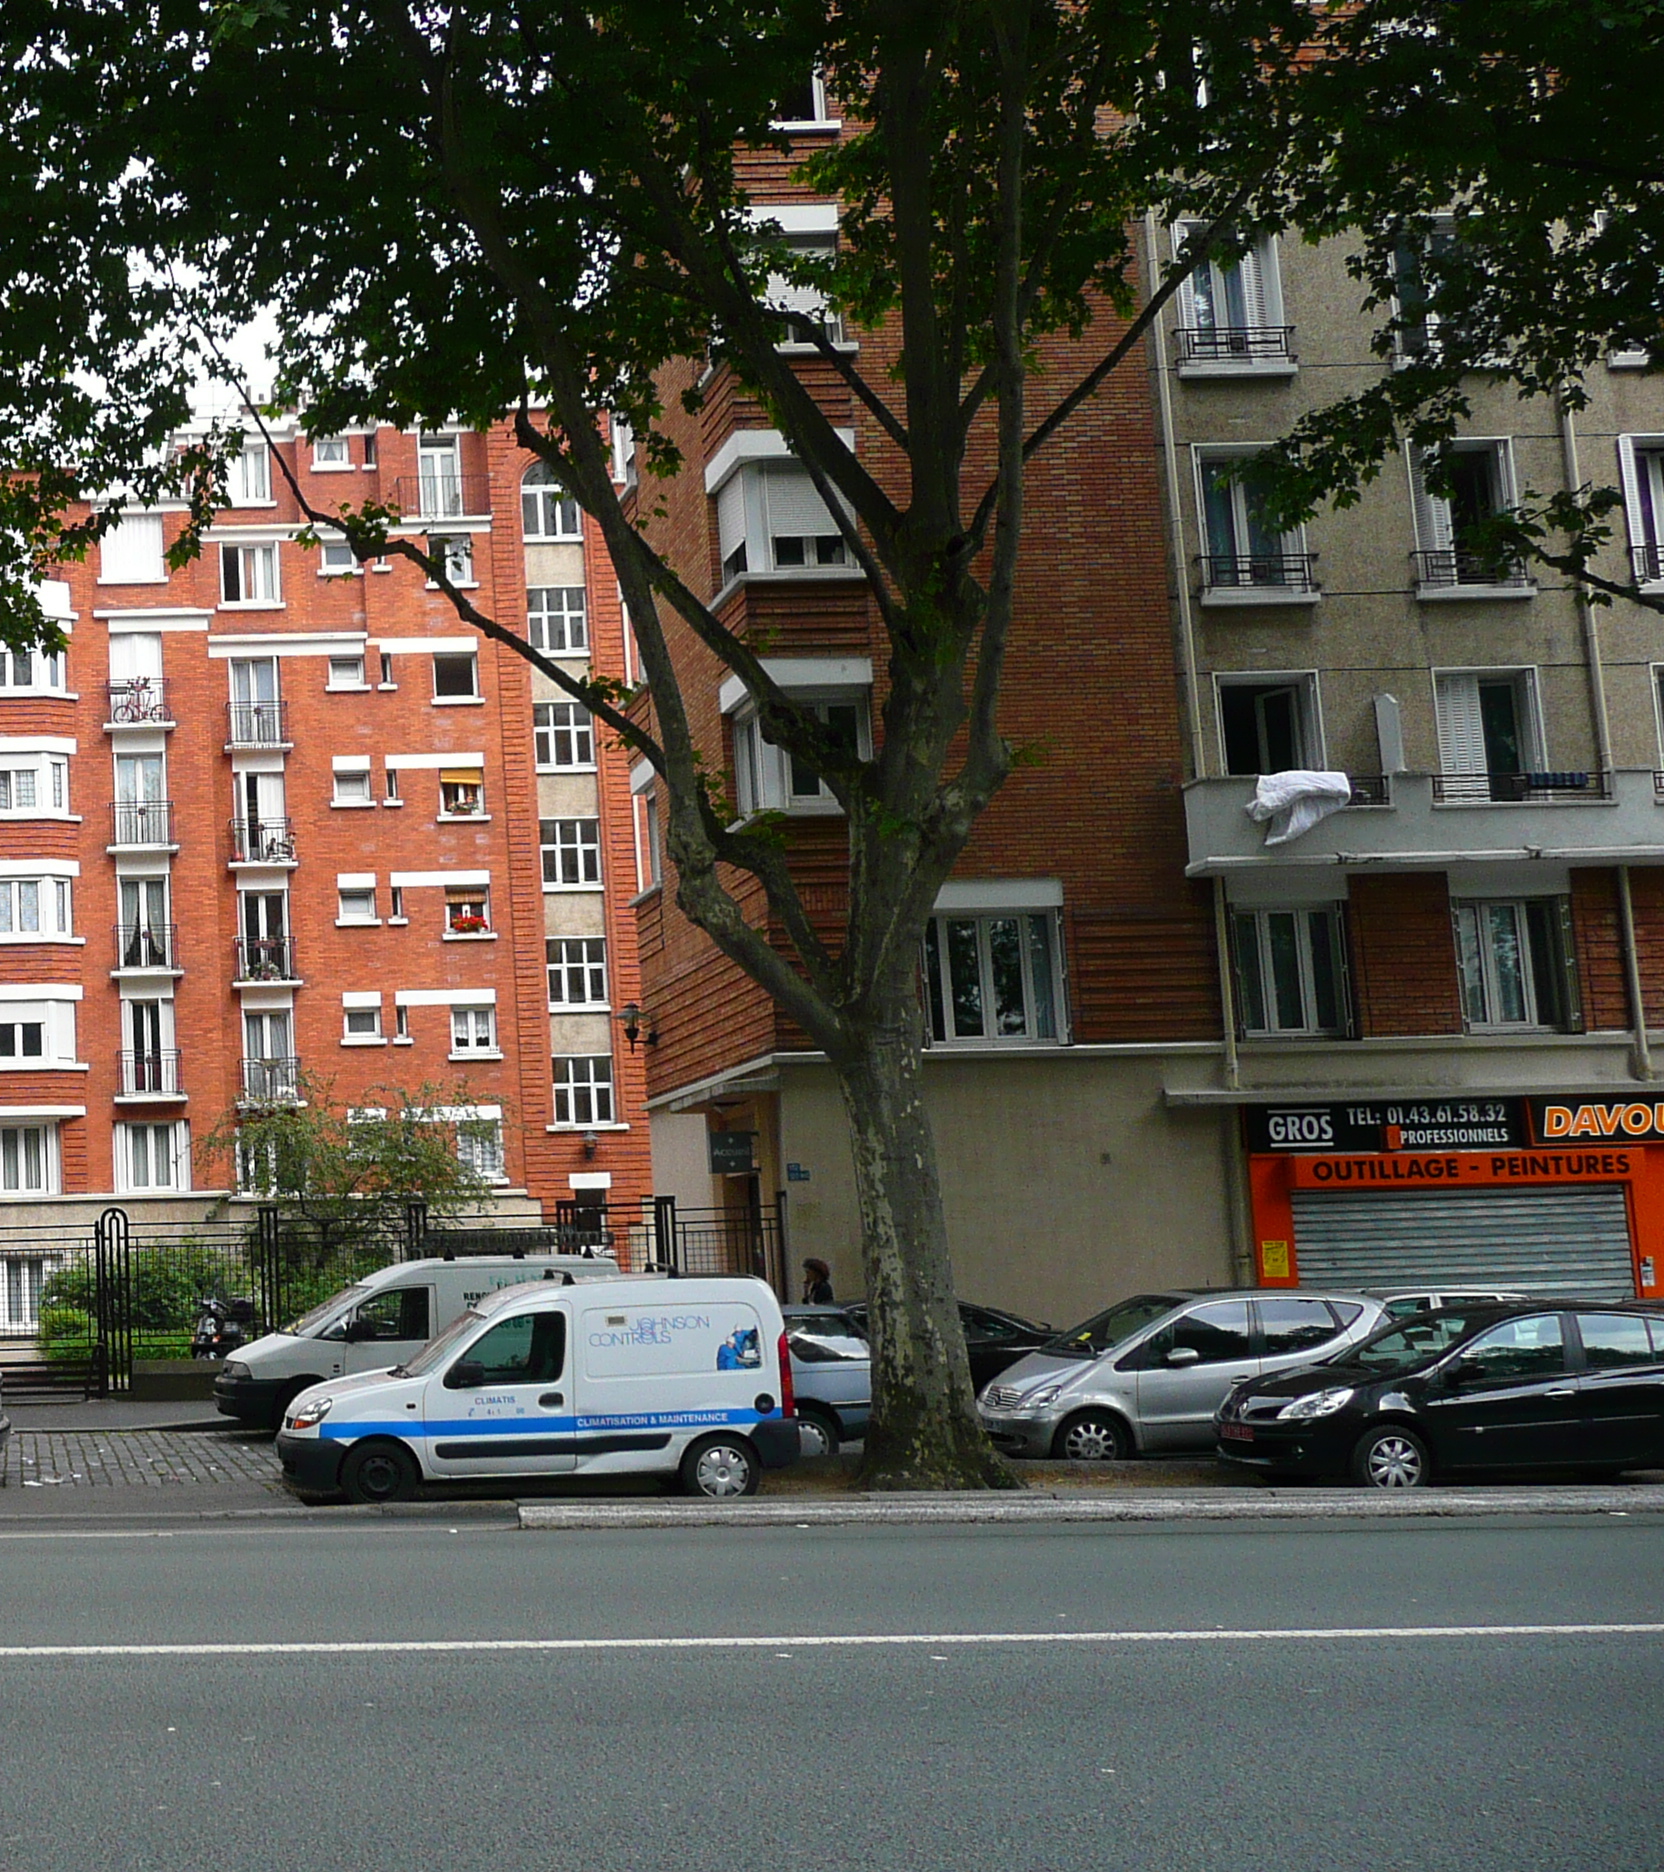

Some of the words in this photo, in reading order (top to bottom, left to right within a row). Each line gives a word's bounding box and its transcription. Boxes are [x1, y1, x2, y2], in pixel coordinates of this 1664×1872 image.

[1347, 1107, 1381, 1125] TEL:
[1387, 1104, 1507, 1124] 01.43.61.58.32
[1268, 1115, 1334, 1141] GROS
[1400, 1128, 1509, 1144] PROFESSIONNELS
[1312, 1158, 1459, 1182] OUTILLAGE
[1491, 1154, 1631, 1177] PEINTURES
[463, 1292, 490, 1301] RENO
[629, 1315, 710, 1332] JOHNSON
[588, 1330, 672, 1348] CONTROLS
[474, 1395, 516, 1406] CLIMATIS
[577, 1415, 648, 1428] CLIMATISATION
[651, 1415, 658, 1425] &
[659, 1412, 729, 1424] MAINTENANCE
